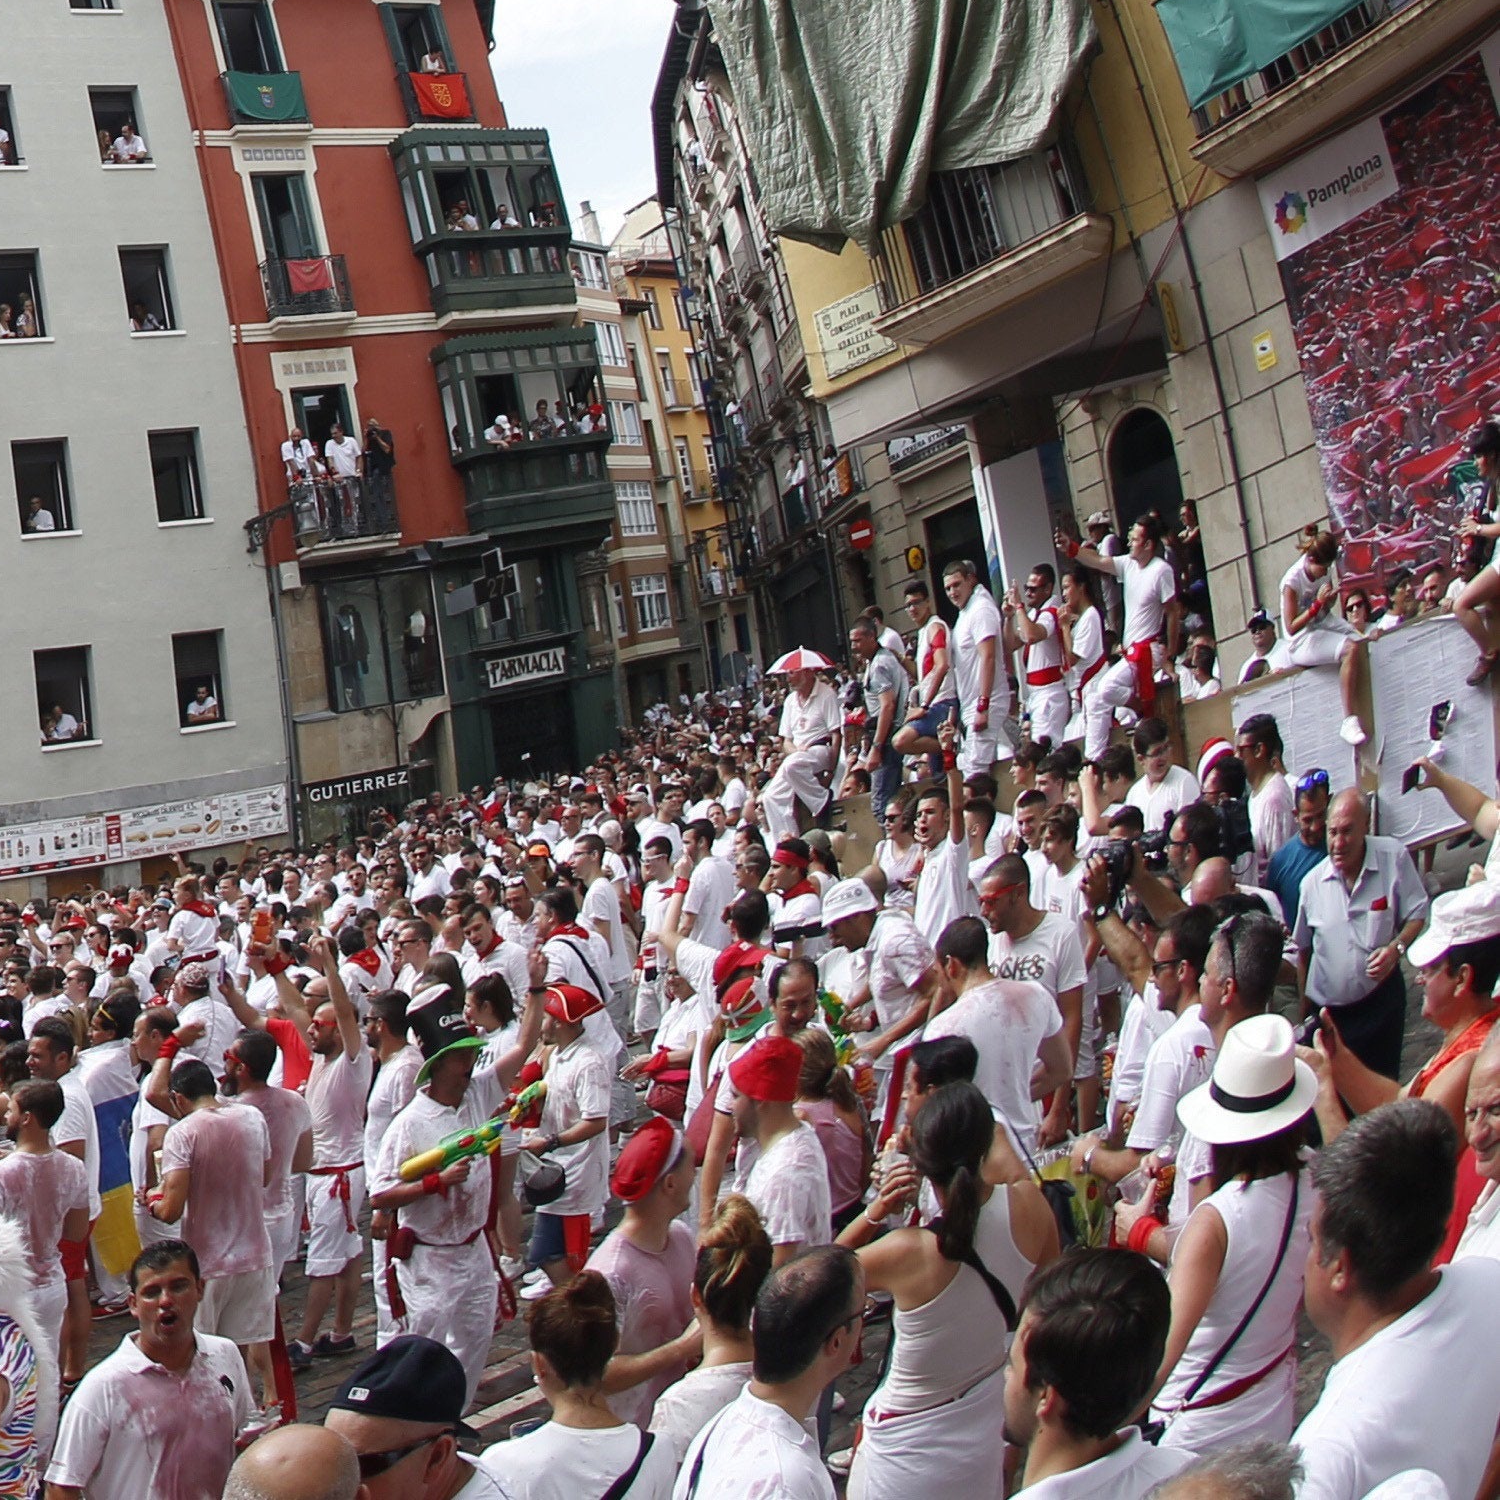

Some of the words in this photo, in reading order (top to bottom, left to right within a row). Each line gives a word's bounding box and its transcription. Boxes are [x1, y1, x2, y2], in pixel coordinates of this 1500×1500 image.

[1307, 154, 1382, 208] Pamplona
[839, 304, 860, 319] PLAZA
[847, 343, 870, 359] PLAZA
[489, 650, 562, 684] FARMACIA
[310, 771, 408, 802] GUTIERREZ
